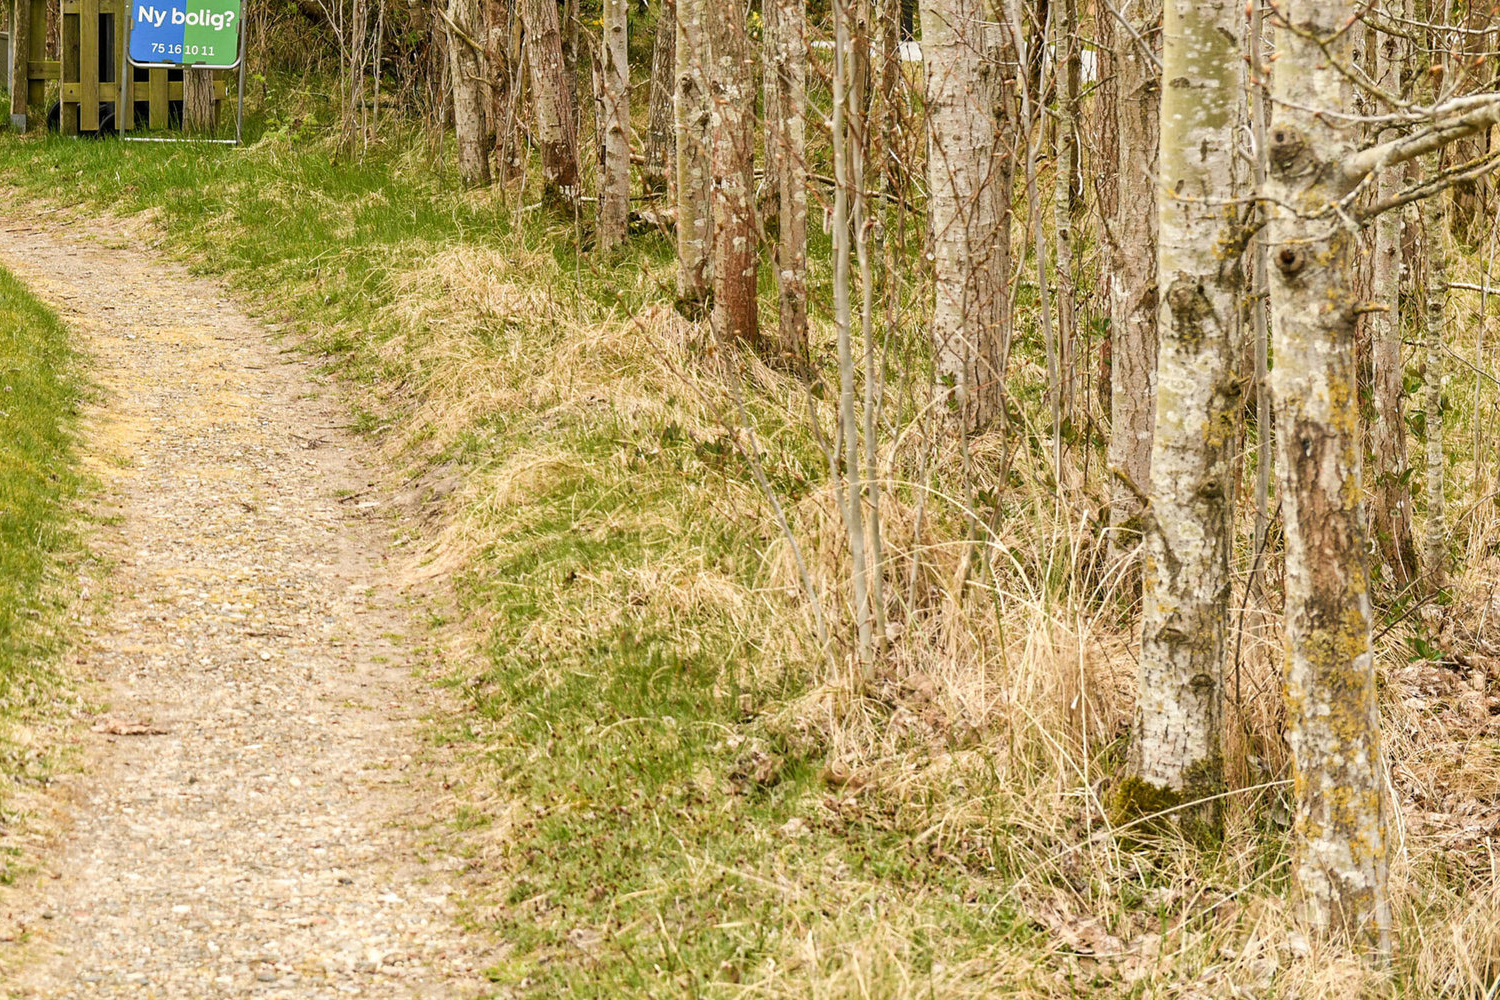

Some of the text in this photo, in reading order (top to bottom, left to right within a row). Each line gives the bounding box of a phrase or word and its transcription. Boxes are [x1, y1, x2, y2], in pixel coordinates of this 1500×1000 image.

[138, 5, 235, 31] Ny bolig?
[151, 43, 214, 56] 75 16 10 11
